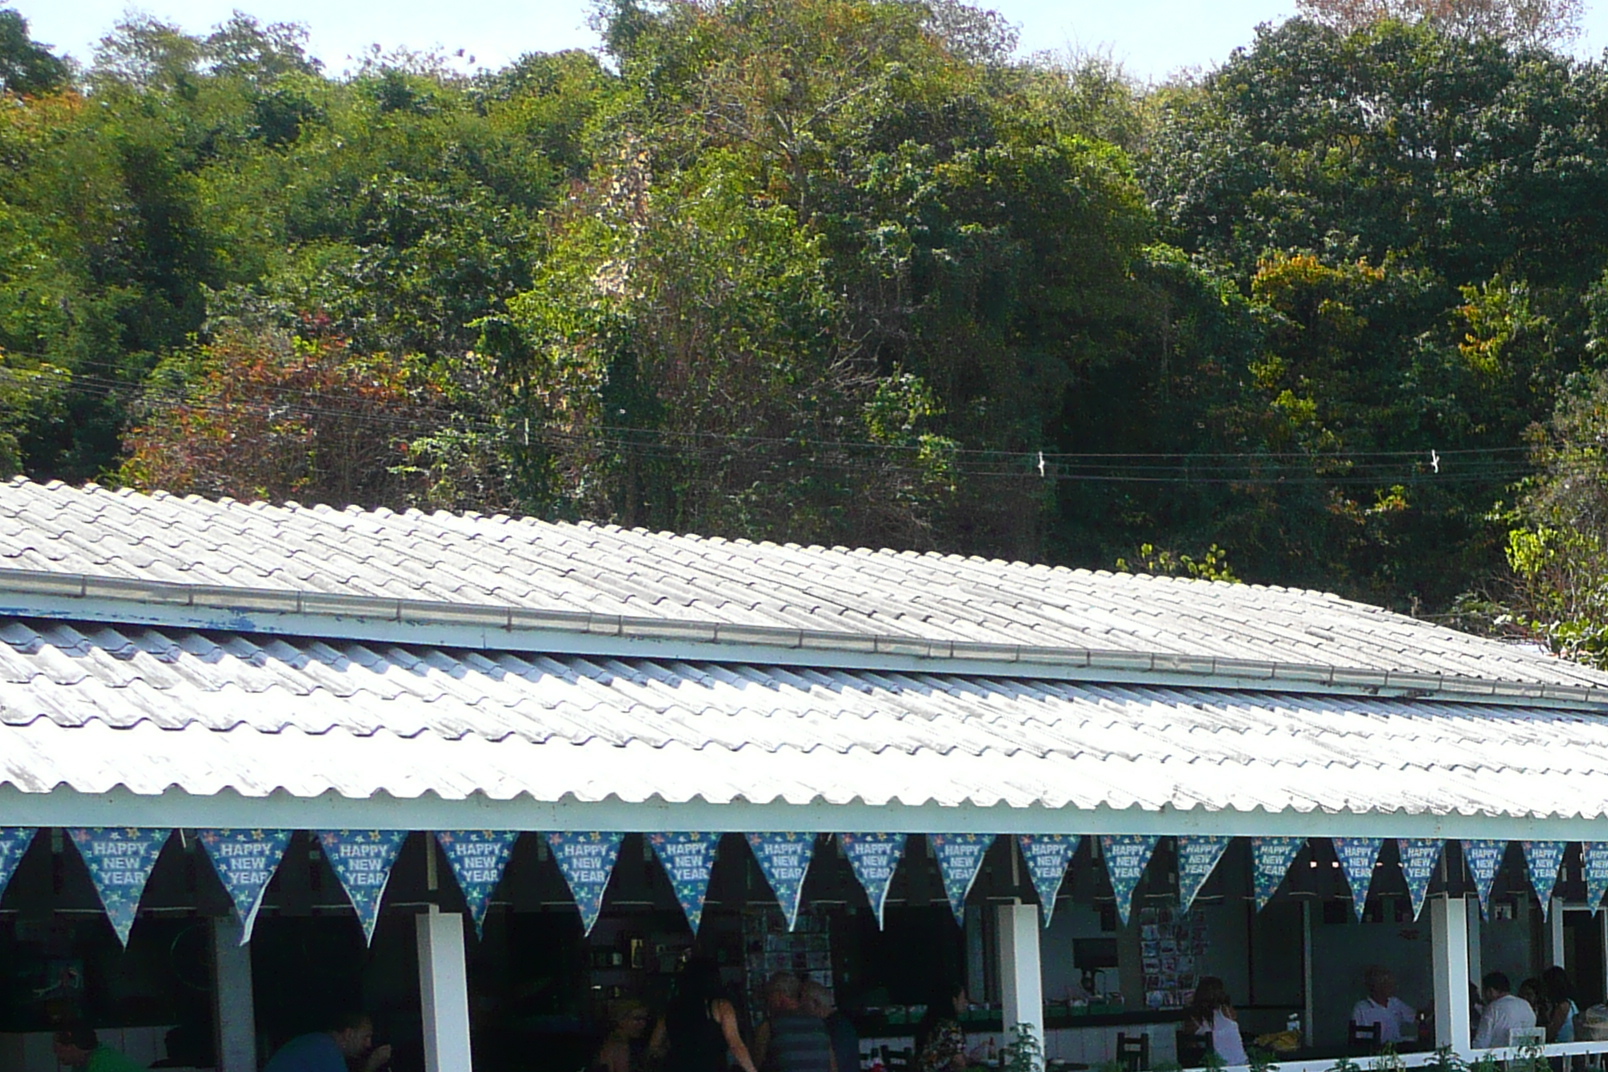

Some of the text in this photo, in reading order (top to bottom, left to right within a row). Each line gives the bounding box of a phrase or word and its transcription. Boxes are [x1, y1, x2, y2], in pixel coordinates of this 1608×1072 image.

[93, 842, 148, 855] HAPPY
[221, 843, 272, 855] HAPPY
[340, 845, 388, 857] HAPPY
[456, 844, 501, 856] HAPPY
[565, 845, 607, 856] HAPPY
[666, 844, 706, 855] HAPPY
[764, 843, 803, 854] HAPPY
[855, 843, 892, 854] HAPPY
[945, 845, 981, 856] HAPPY
[1032, 845, 1065, 855] HAPPY
[1112, 845, 1144, 856] HAPPY
[1186, 845, 1218, 854] HAPPY
[1260, 846, 1291, 855] HAPPY
[1344, 847, 1372, 857] HAPPY
[1408, 848, 1435, 857] HAPPY
[1471, 849, 1498, 858] HAPPY
[1532, 849, 1557, 858] HAPPY
[104, 857, 140, 869] NEW
[231, 858, 266, 869] NEW
[349, 859, 382, 870] NEW
[464, 857, 496, 868] NEW
[573, 857, 600, 868] NEW
[675, 856, 702, 866] NEW
[772, 856, 798, 866] NEW
[863, 856, 888, 866] NEW
[950, 857, 974, 867] NEW
[1038, 856, 1062, 866] NEW
[1117, 857, 1140, 866] NEW
[1189, 855, 1212, 864] NEW
[1263, 856, 1286, 865] NEW
[1349, 858, 1368, 867] NEW
[1411, 858, 1431, 867] NEW
[1476, 859, 1494, 868] NEW
[1535, 859, 1554, 868] NEW
[674, 869, 708, 880] YEAR
[772, 868, 802, 879] YEAR
[861, 868, 891, 878] YEAR
[1036, 868, 1063, 878] YEAR
[1115, 868, 1140, 878] YEAR
[1187, 865, 1212, 874] YEAR
[1260, 865, 1286, 876] YEAR
[1350, 868, 1372, 877] YEAR
[1534, 868, 1557, 878] YEAR
[102, 872, 145, 884] YEAR
[346, 872, 384, 884] YEAR
[464, 870, 498, 882] YEAR
[571, 871, 605, 882] YEAR
